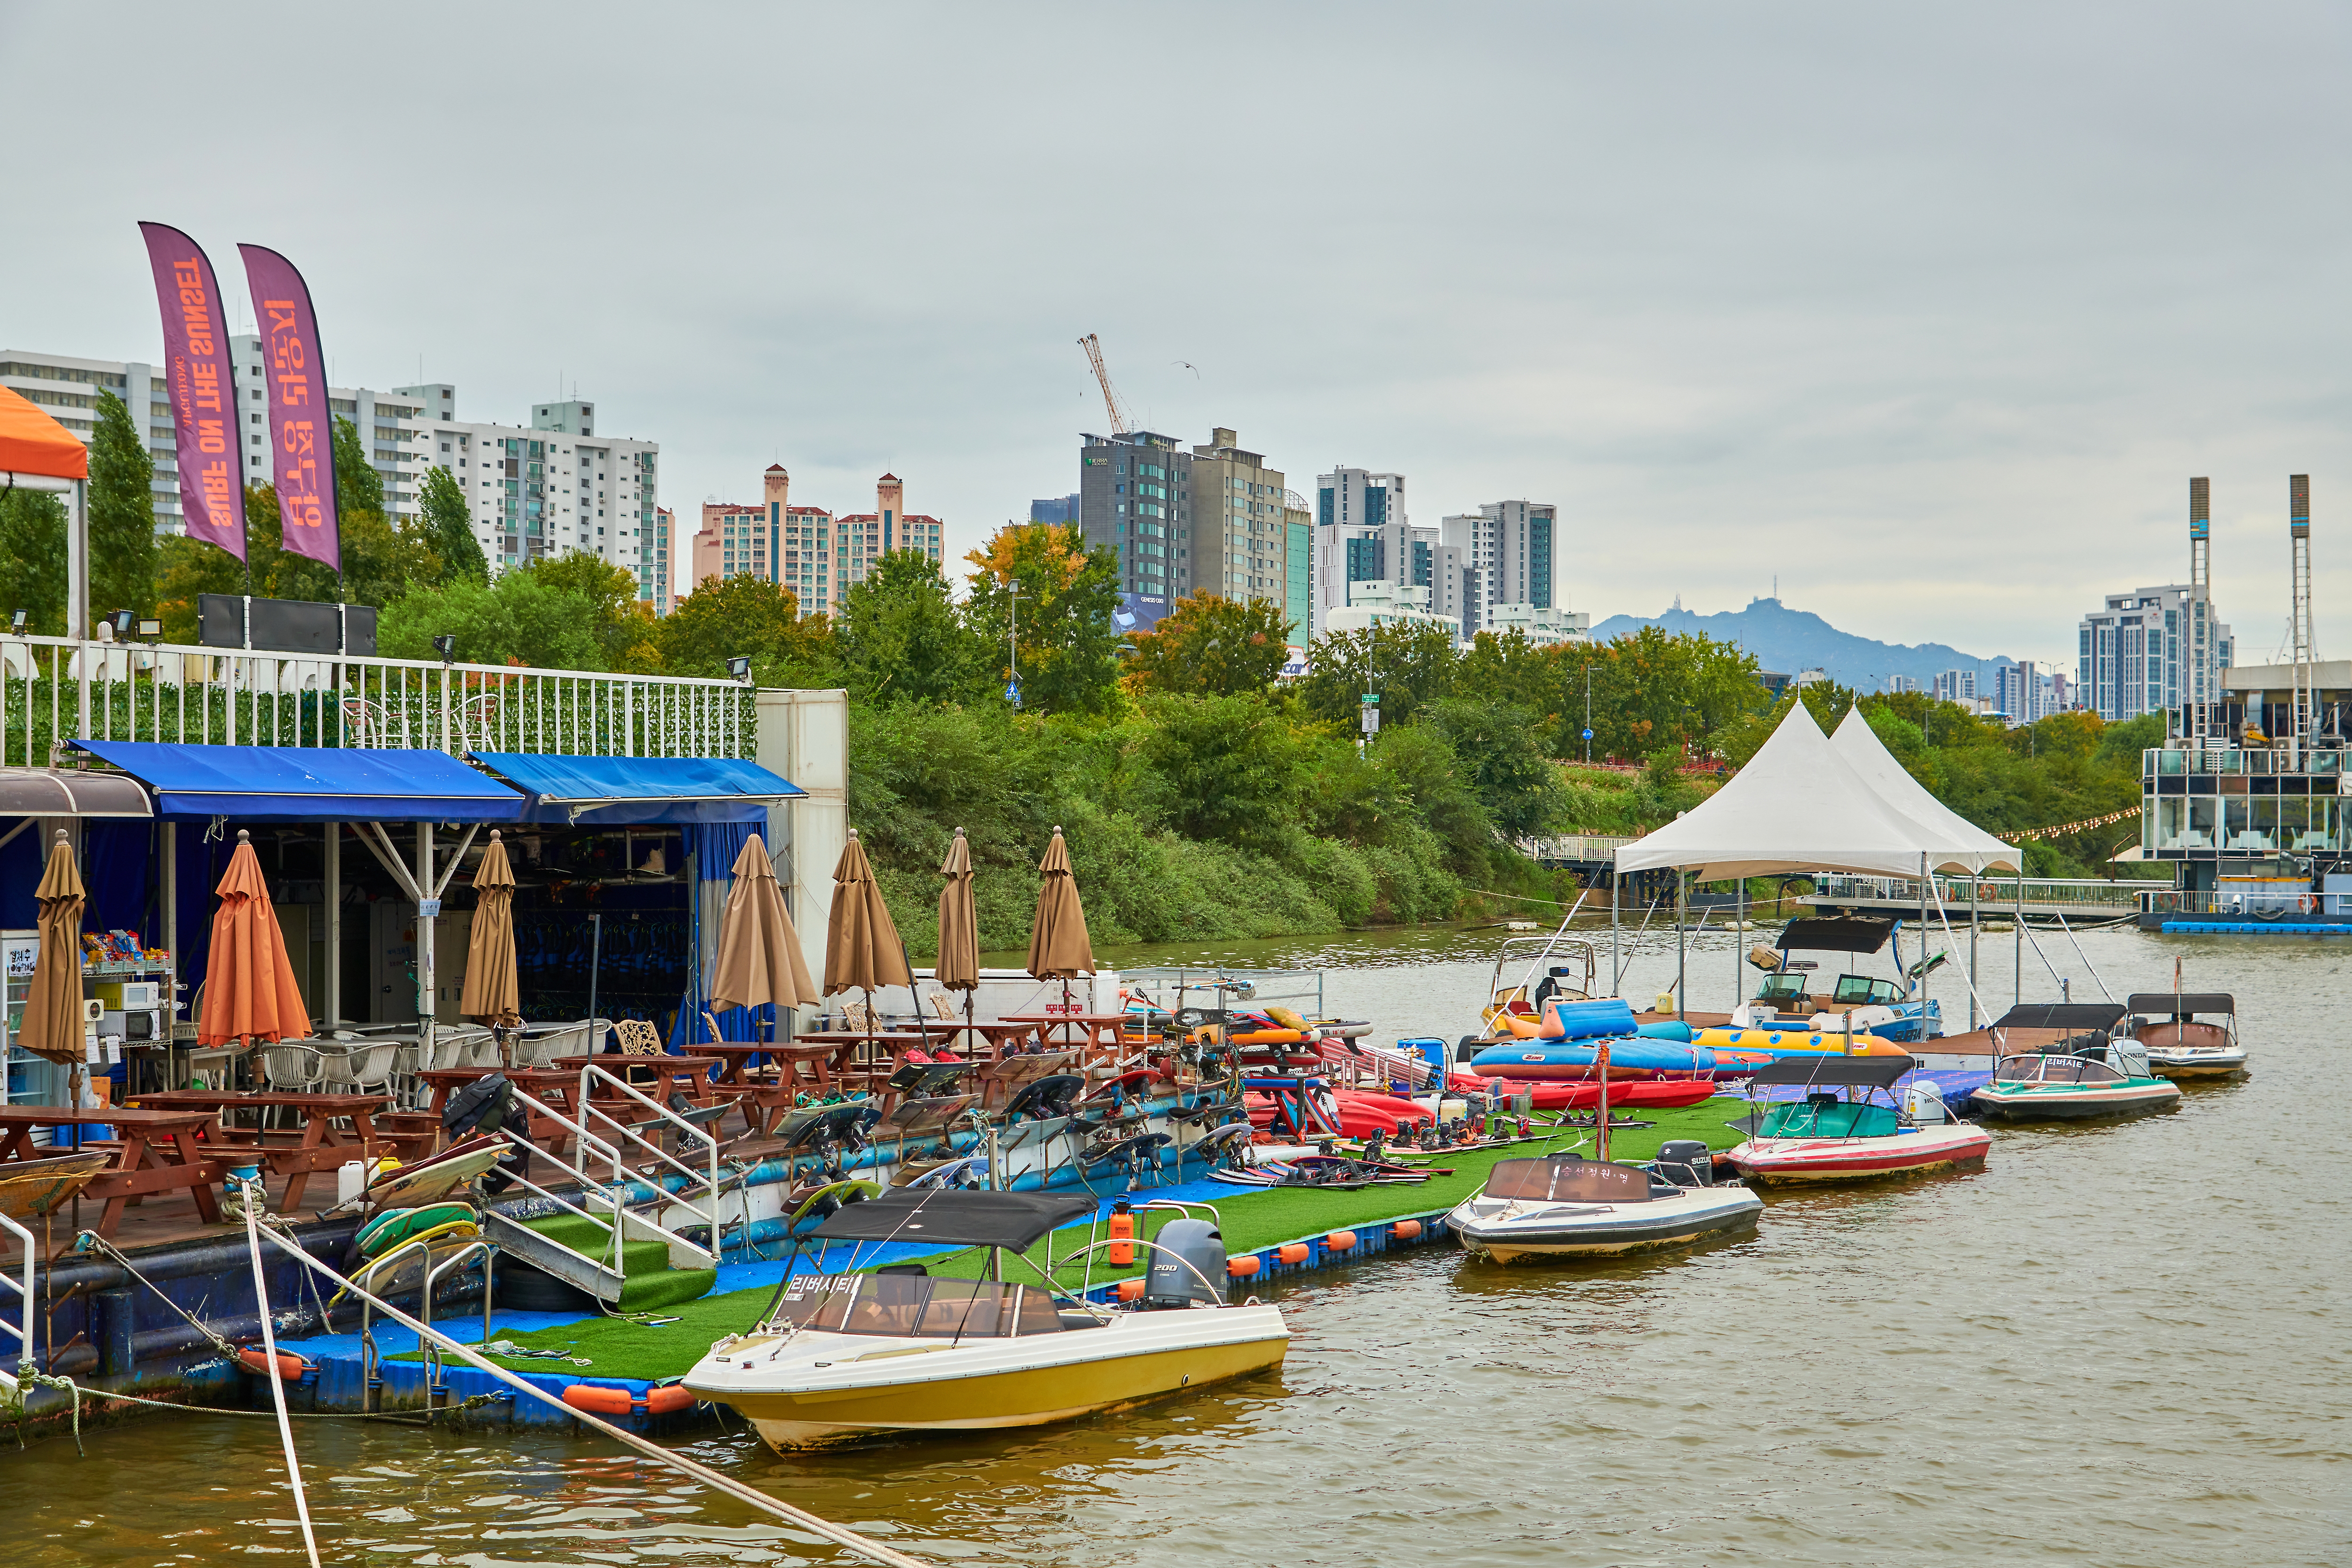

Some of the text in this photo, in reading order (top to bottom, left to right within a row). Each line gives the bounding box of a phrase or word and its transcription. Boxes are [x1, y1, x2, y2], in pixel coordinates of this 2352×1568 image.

[1388, 584, 1428, 599] 한 강
[1528, 607, 1562, 621] 한 강
[1279, 663, 1305, 674] car
[1924, 1095, 1942, 1104] HODA
[1691, 1156, 1710, 1165] SUZUK
[1561, 1166, 1611, 1180] 승선정원
